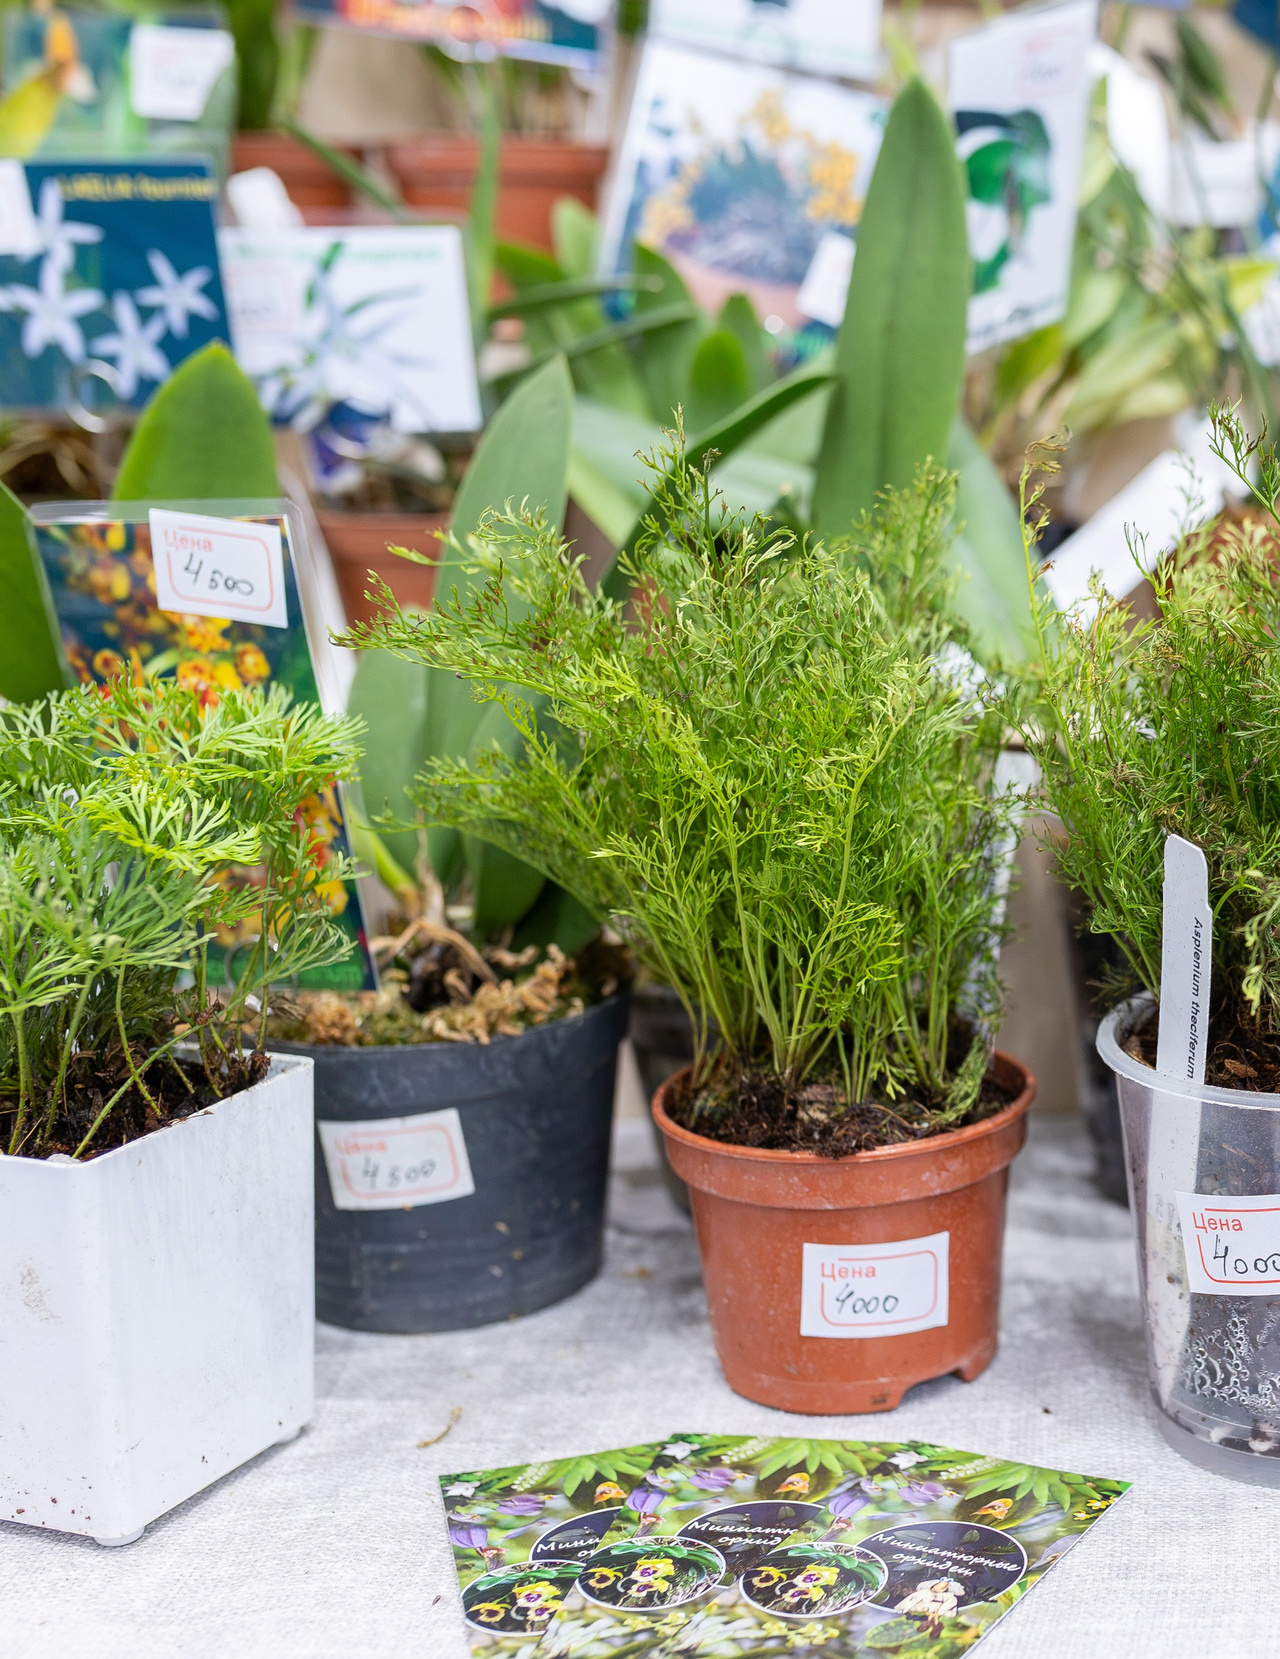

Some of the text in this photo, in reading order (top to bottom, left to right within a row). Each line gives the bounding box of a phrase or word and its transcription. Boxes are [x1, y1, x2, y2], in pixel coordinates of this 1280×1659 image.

[163, 528, 213, 552] Цена
[1186, 916, 1204, 1080] Asplenium theciferum
[1192, 1211, 1244, 1234] Цена
[820, 1262, 877, 1282] Цена
[835, 1282, 899, 1314] 4000
[870, 1533, 1021, 1571] Миниатюрные
[892, 1553, 976, 1577] орхидеи
